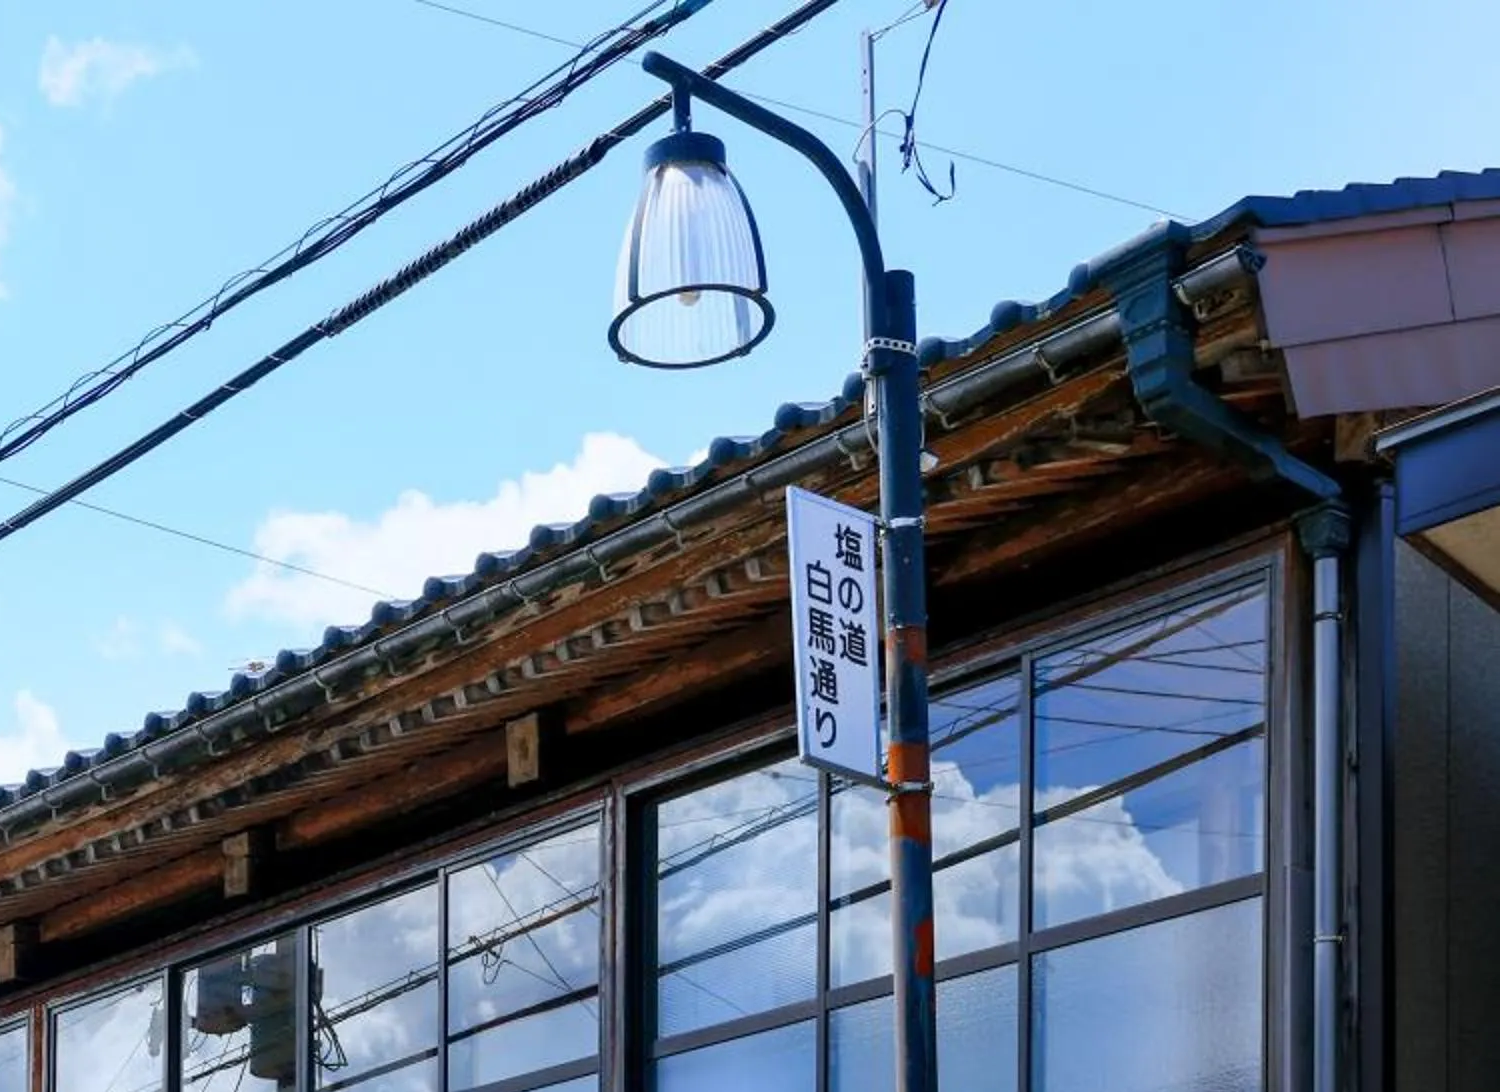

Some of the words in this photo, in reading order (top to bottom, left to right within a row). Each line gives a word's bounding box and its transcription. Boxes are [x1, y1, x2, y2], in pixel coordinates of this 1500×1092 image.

[806, 560, 838, 748] 白馬通り
[834, 523, 868, 667] 塩の道
